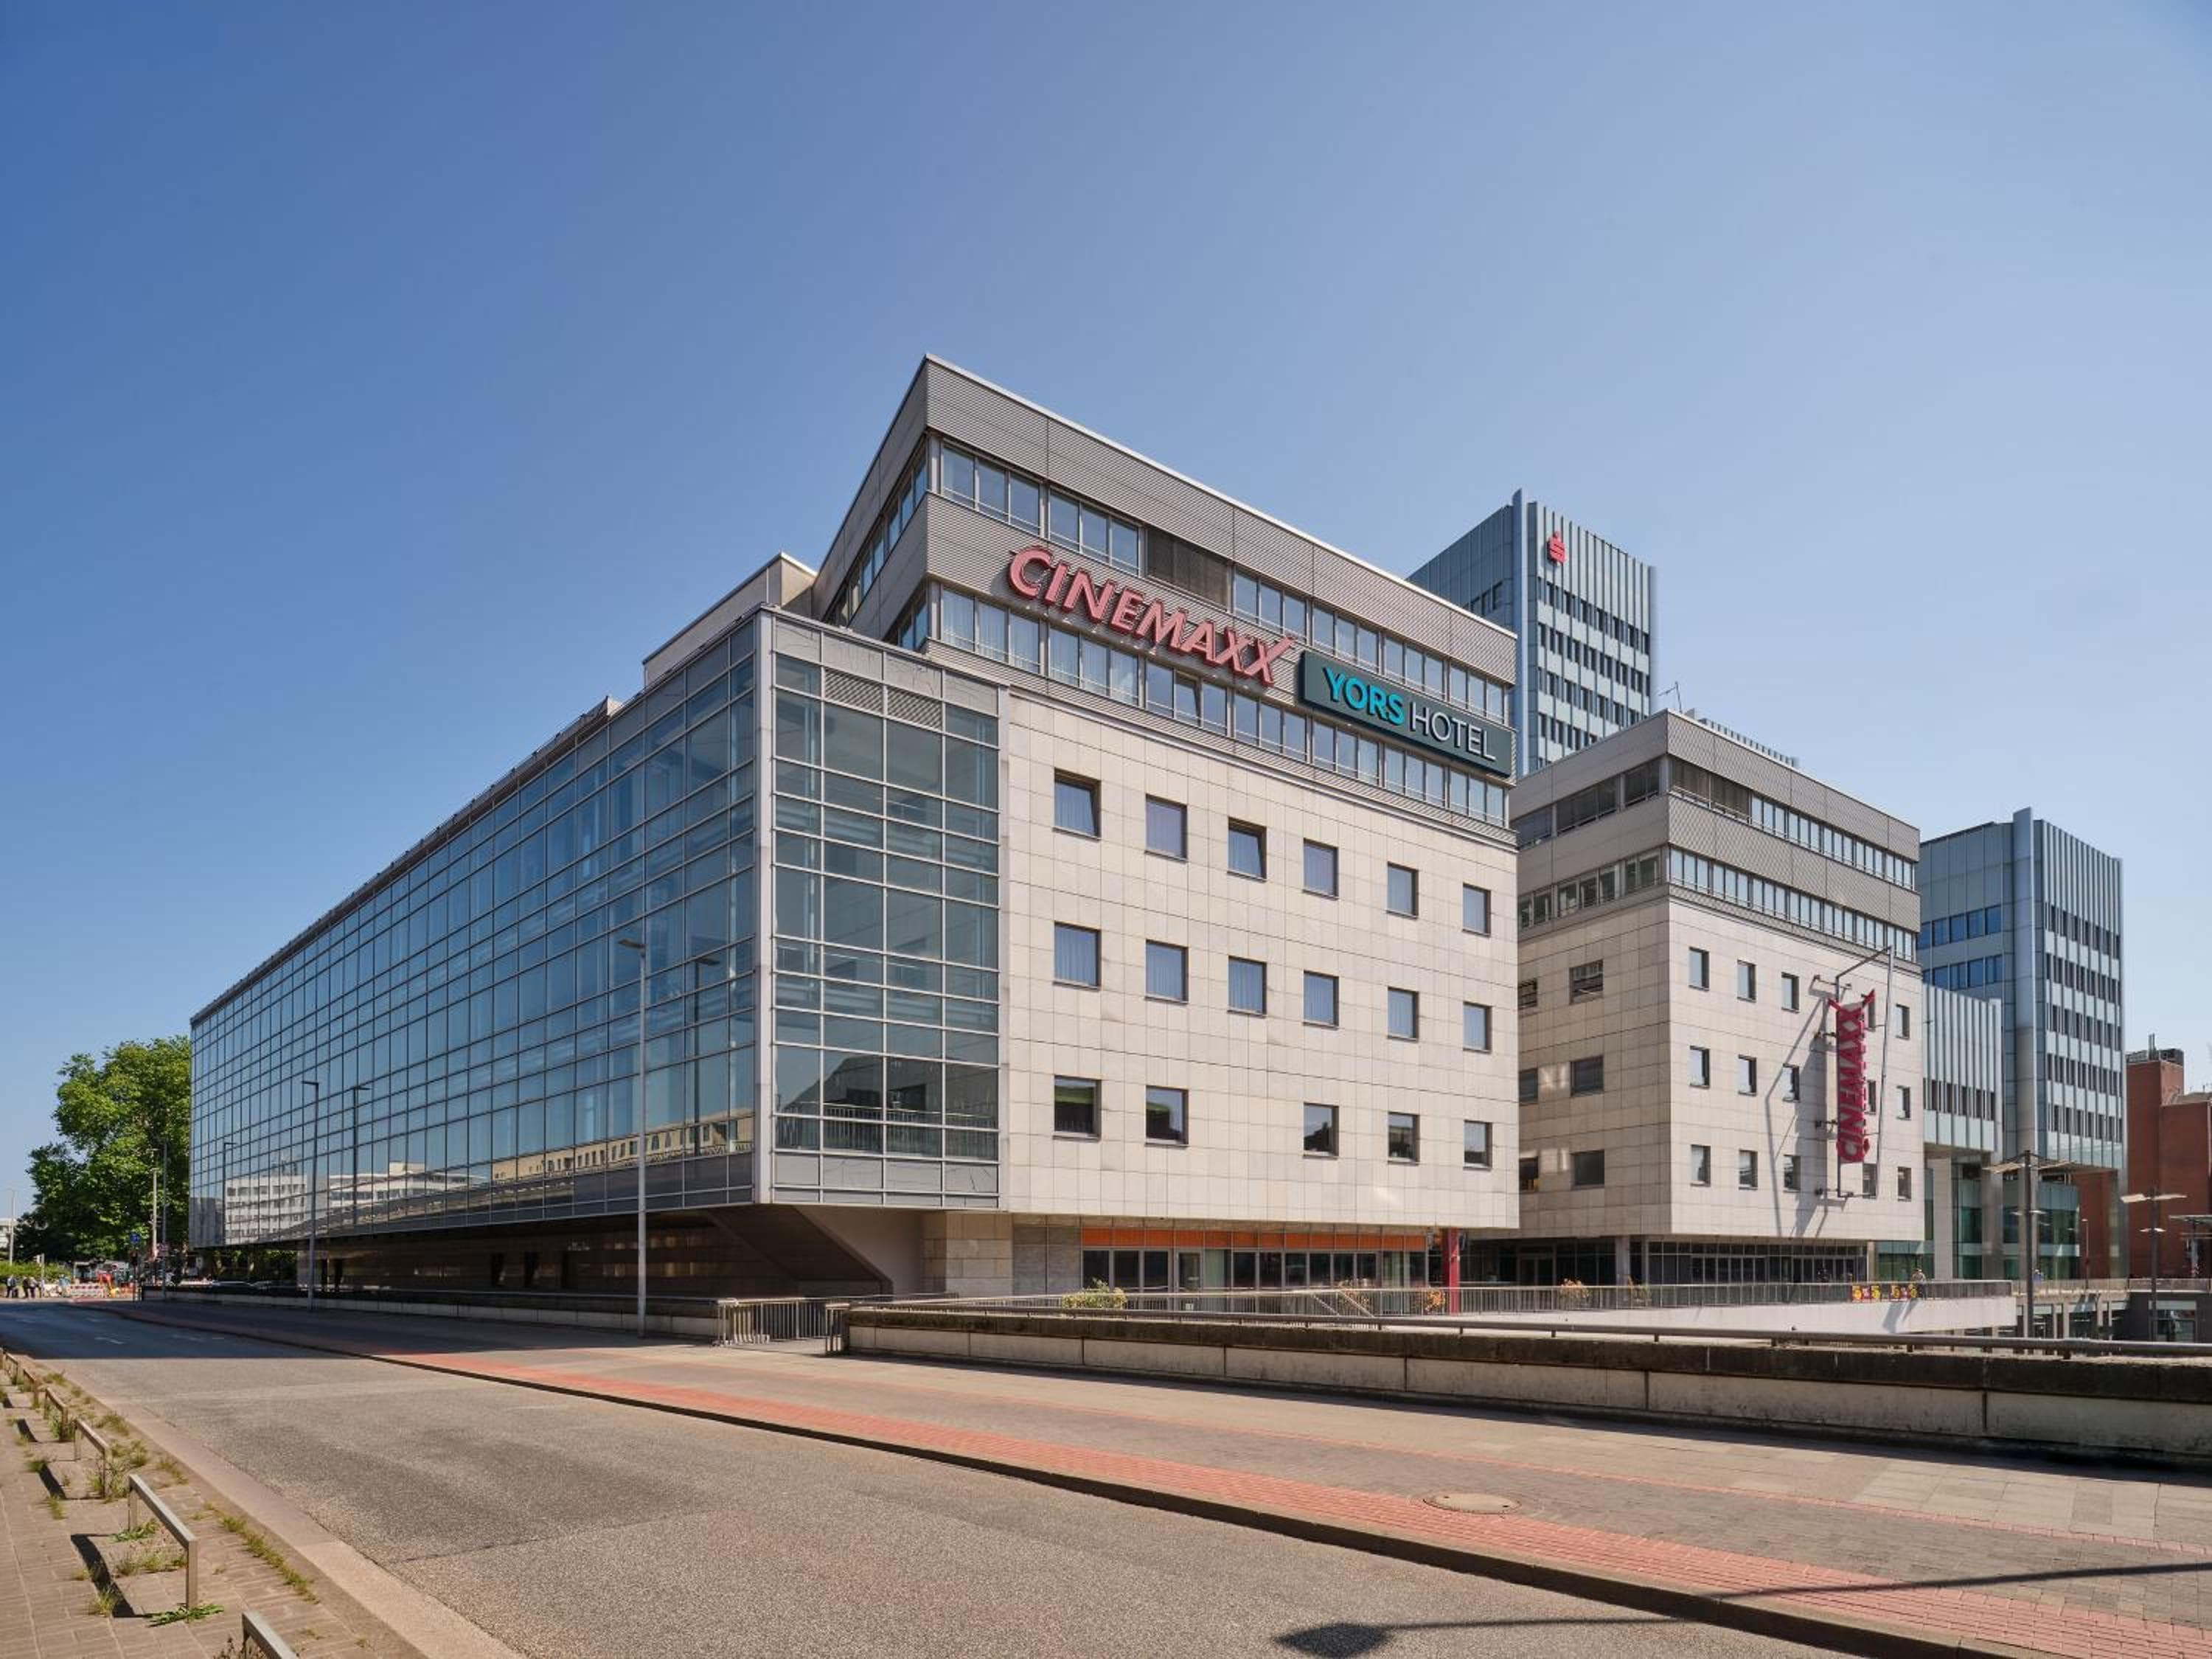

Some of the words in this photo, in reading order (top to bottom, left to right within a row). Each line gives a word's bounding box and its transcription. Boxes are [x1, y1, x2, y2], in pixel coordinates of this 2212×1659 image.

[1009, 546, 1295, 687] CINEMAXX
[1323, 667, 1404, 726] YORS
[1410, 701, 1496, 761] HOTEL
